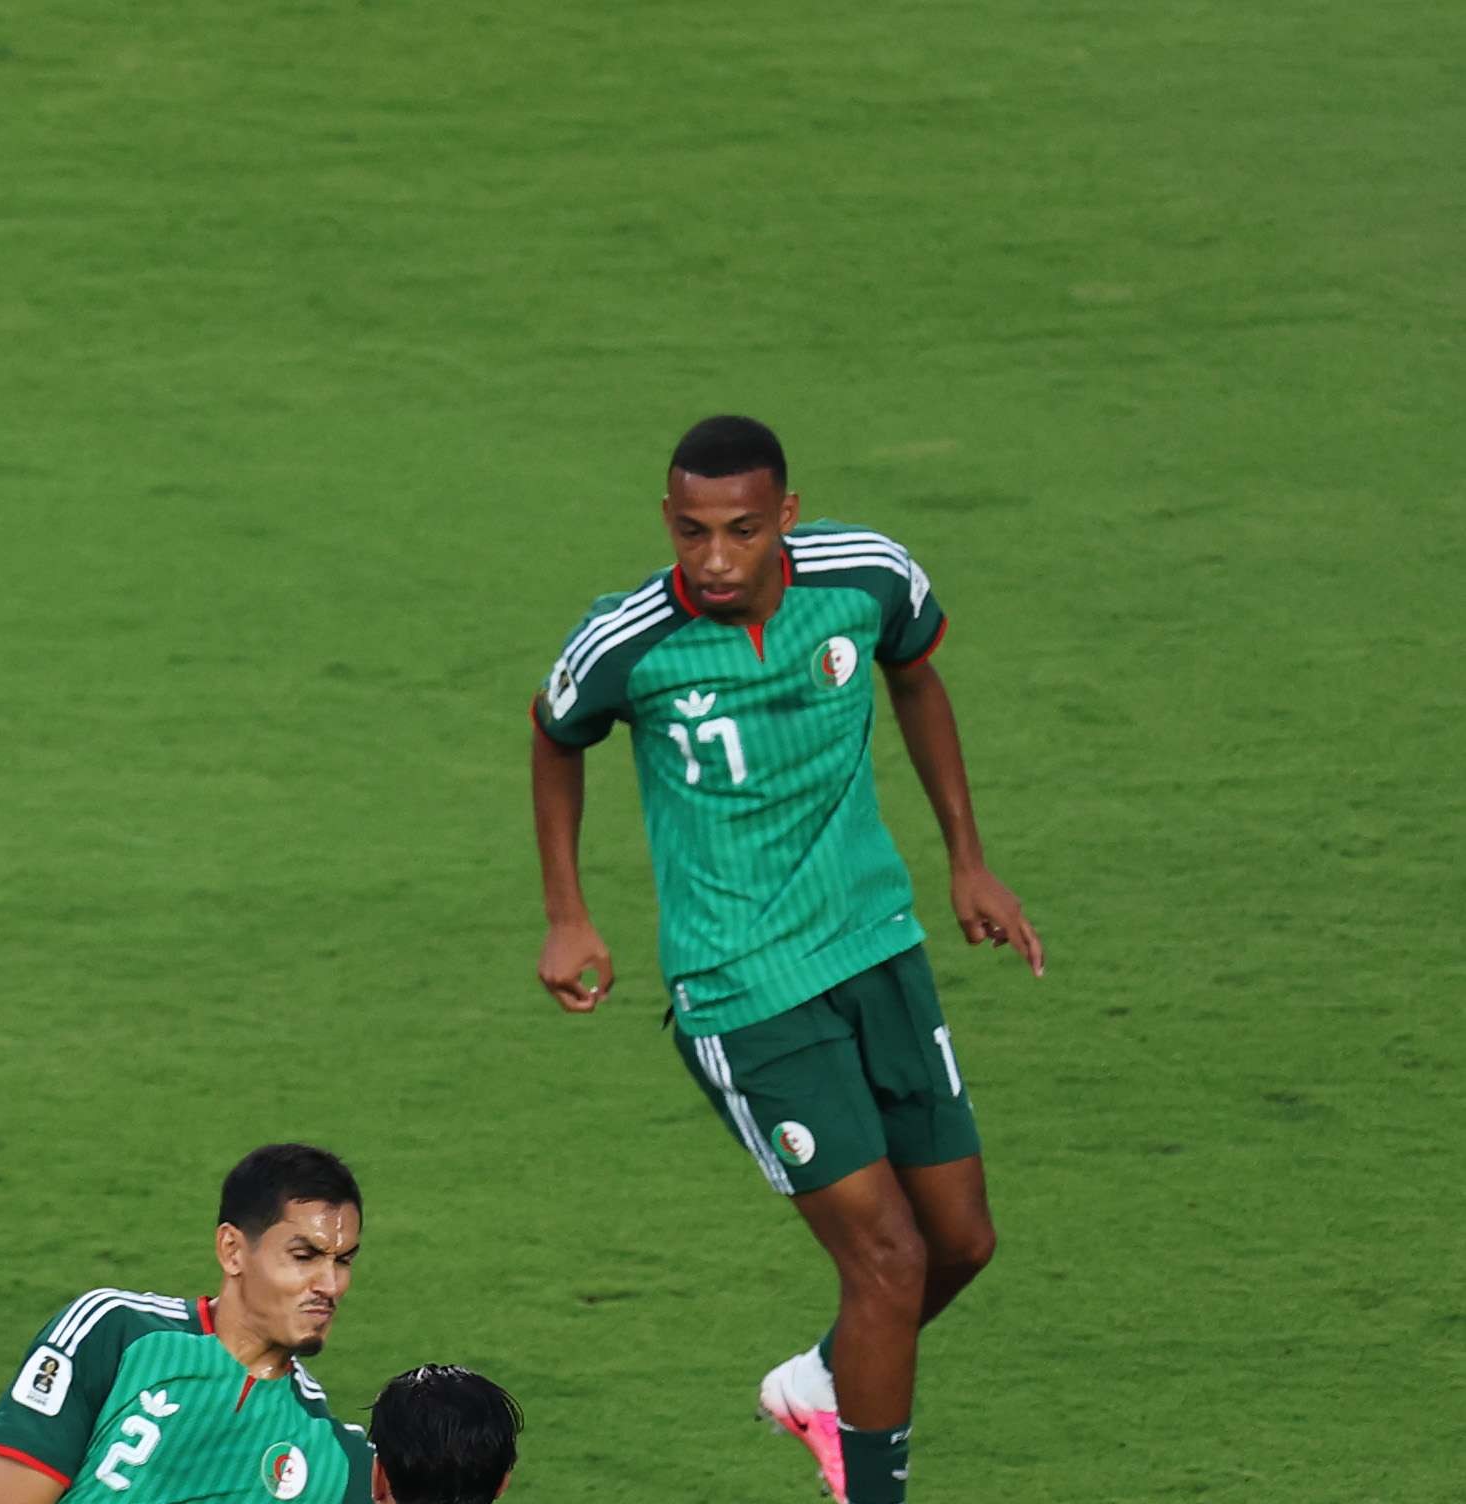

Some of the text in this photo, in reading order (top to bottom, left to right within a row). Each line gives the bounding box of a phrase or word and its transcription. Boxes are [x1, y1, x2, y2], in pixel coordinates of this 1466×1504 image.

[668, 716, 748, 785] 17
[933, 1025, 962, 1098] 1
[95, 1414, 162, 1491] 2
